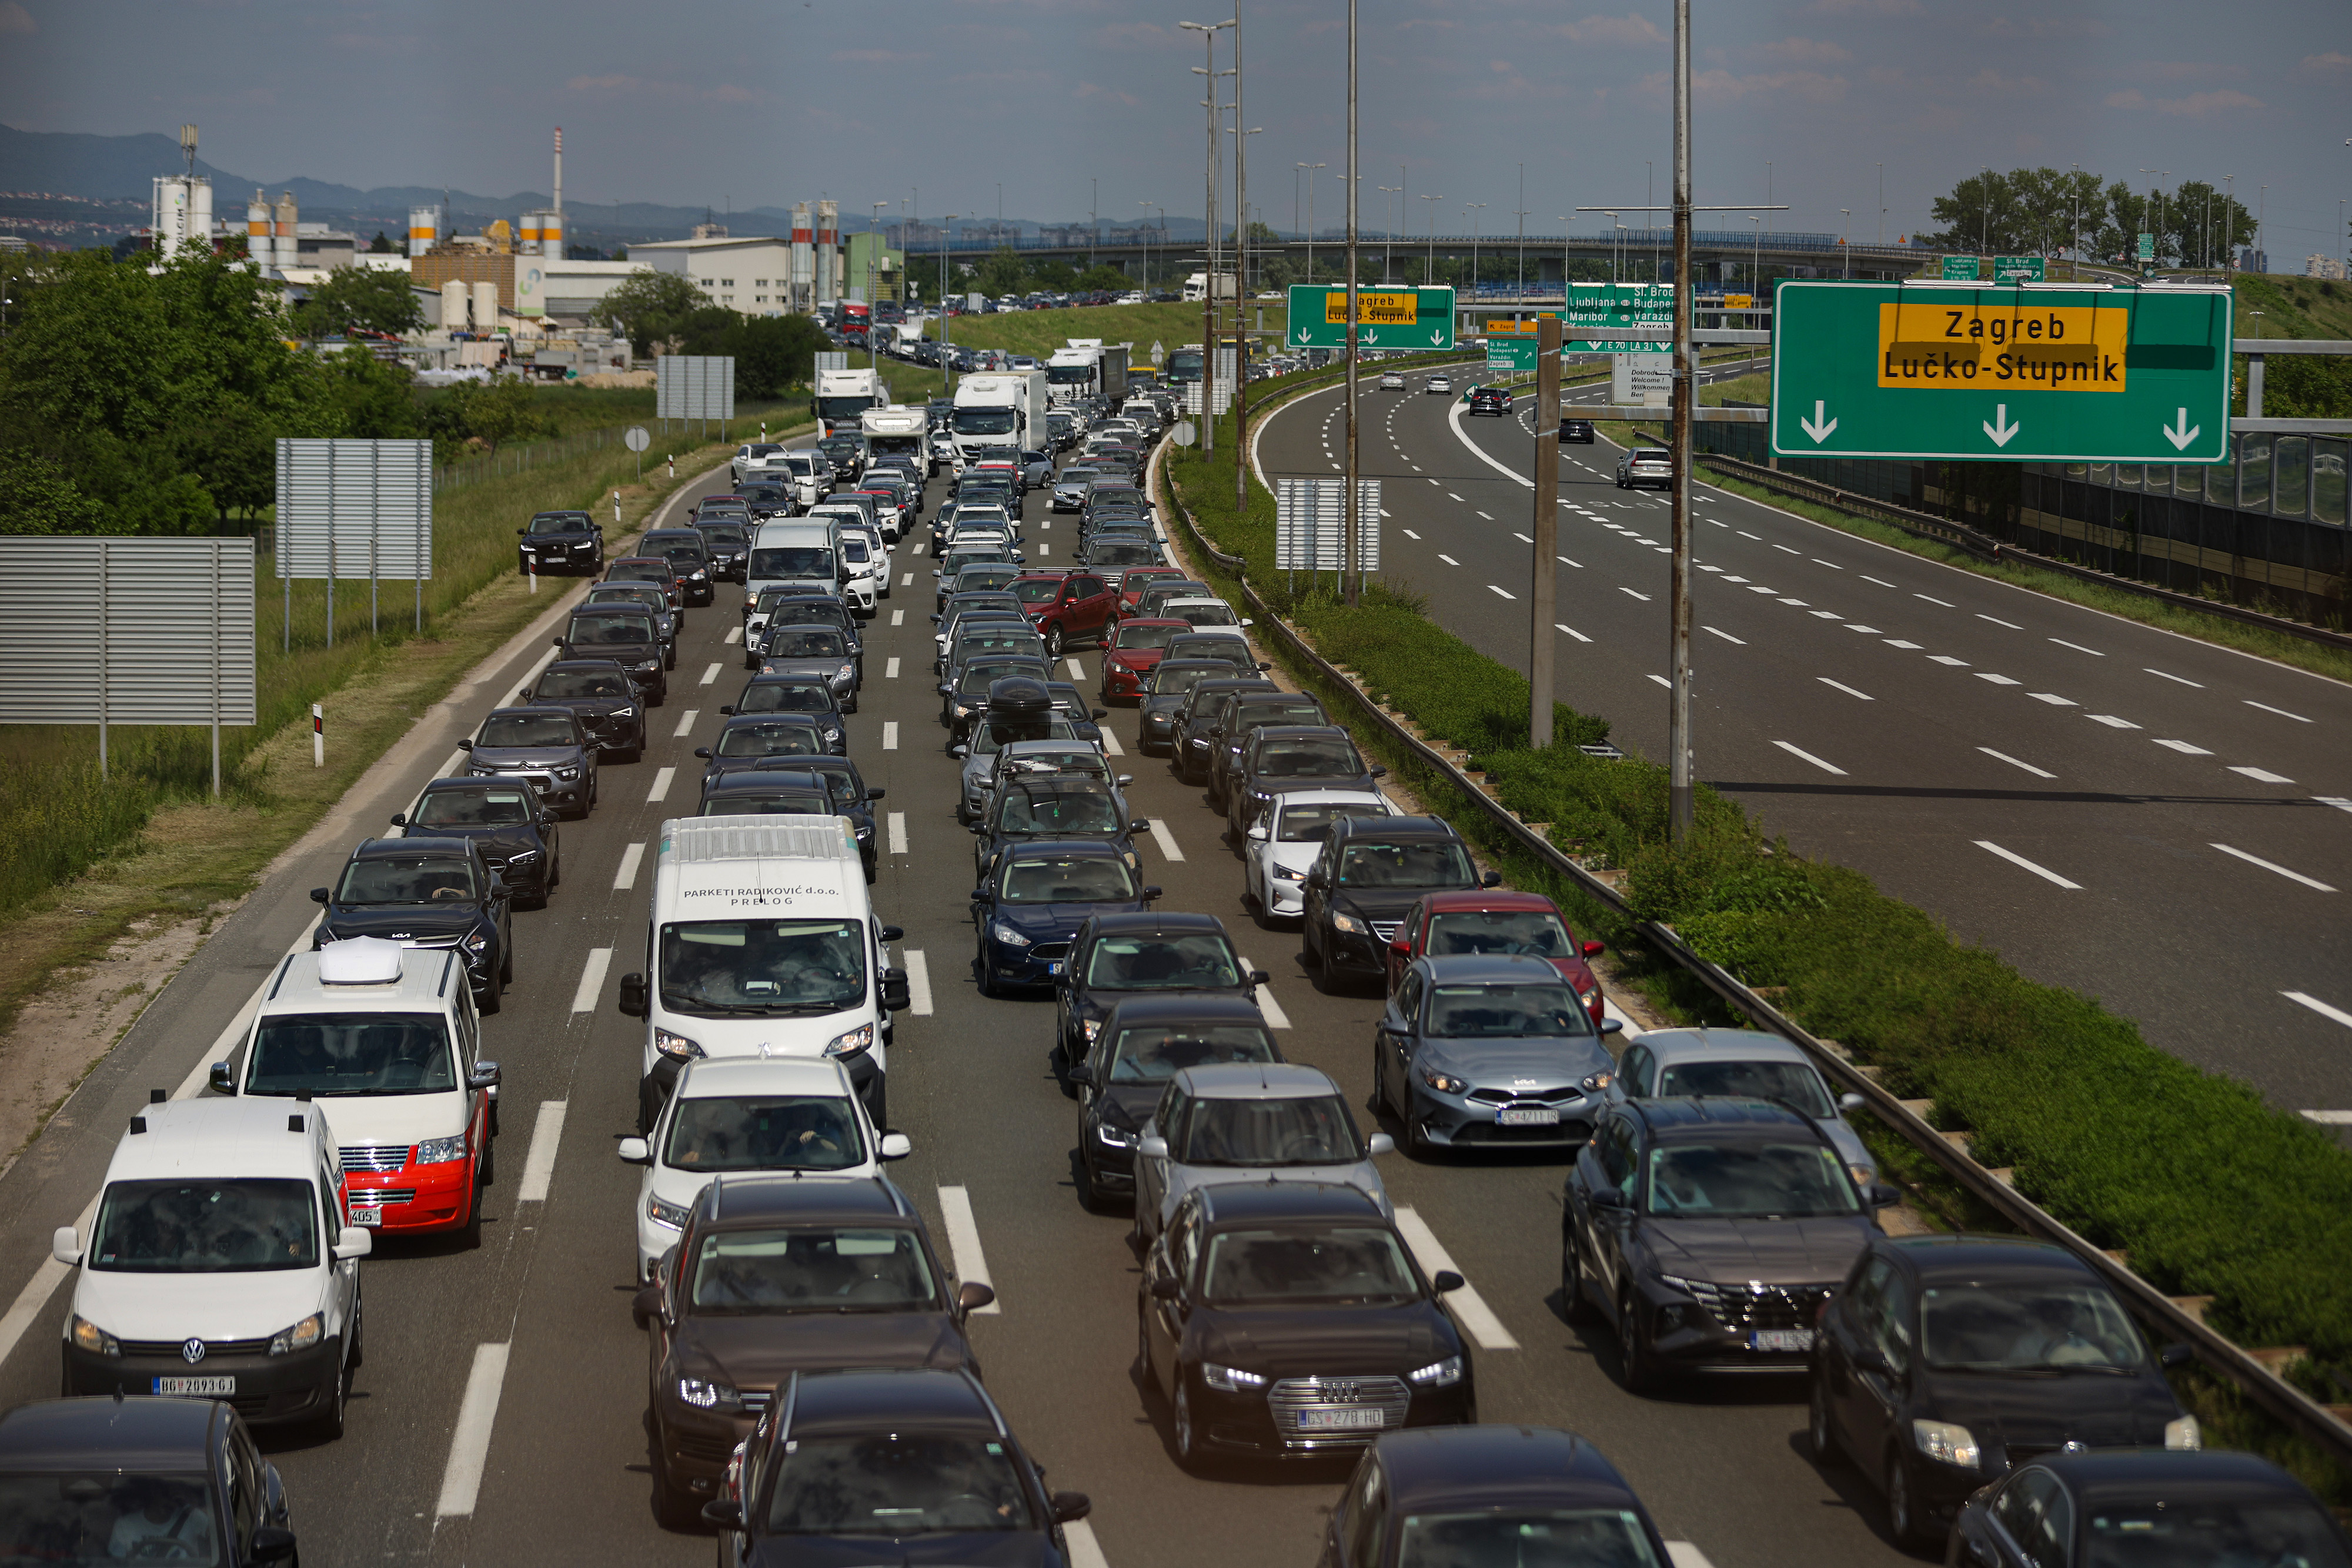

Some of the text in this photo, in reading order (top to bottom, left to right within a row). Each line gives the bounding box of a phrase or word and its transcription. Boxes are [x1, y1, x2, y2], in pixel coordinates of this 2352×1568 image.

[1358, 296, 1394, 307] agreb
[1570, 297, 1616, 309] Ljubljana
[1328, 310, 1414, 323] Lučo-Stupnik
[1569, 312, 1608, 321] Maribor
[1634, 311, 1673, 321] Varaždi
[1945, 311, 2064, 345] Zagreb
[1885, 352, 2119, 387] Lučko-Stupnik
[684, 885, 839, 898] PARKETI RADIKOVIĆ d.o.o.
[731, 897, 793, 906] PRELOG
